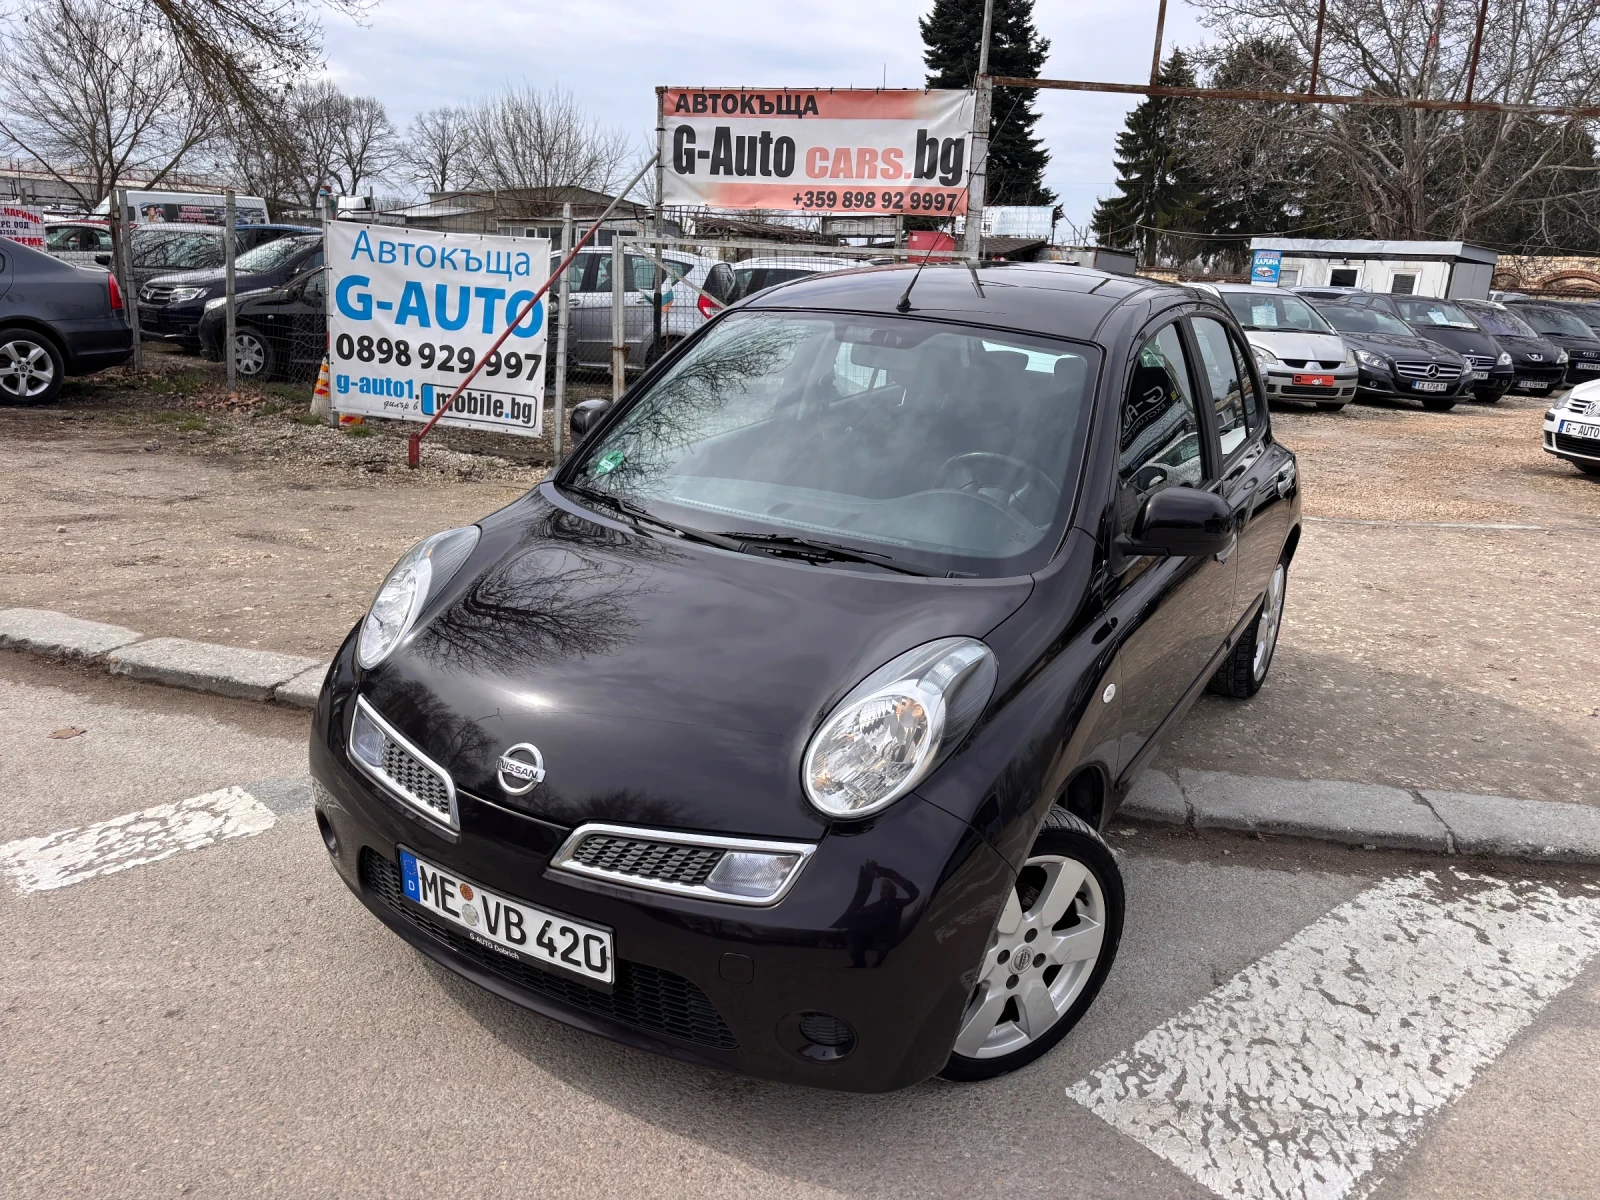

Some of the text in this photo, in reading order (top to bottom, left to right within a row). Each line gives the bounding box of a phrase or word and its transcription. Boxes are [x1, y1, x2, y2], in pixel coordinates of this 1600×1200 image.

[674, 93, 819, 119] АВТОКЪЩА
[673, 124, 796, 178] G-Auto
[792, 191, 957, 212] +359 898 92 9997
[350, 229, 531, 282] Автокъща
[335, 274, 544, 338] G-AUTO
[335, 333, 543, 381] 0898 929 997
[436, 391, 533, 425] mobile.bg
[500, 760, 538, 779] NISSAN
[408, 880, 416, 892] D
[420, 865, 608, 973] ME VB 420
[469, 932, 520, 960] G-AUTO Dobrich
